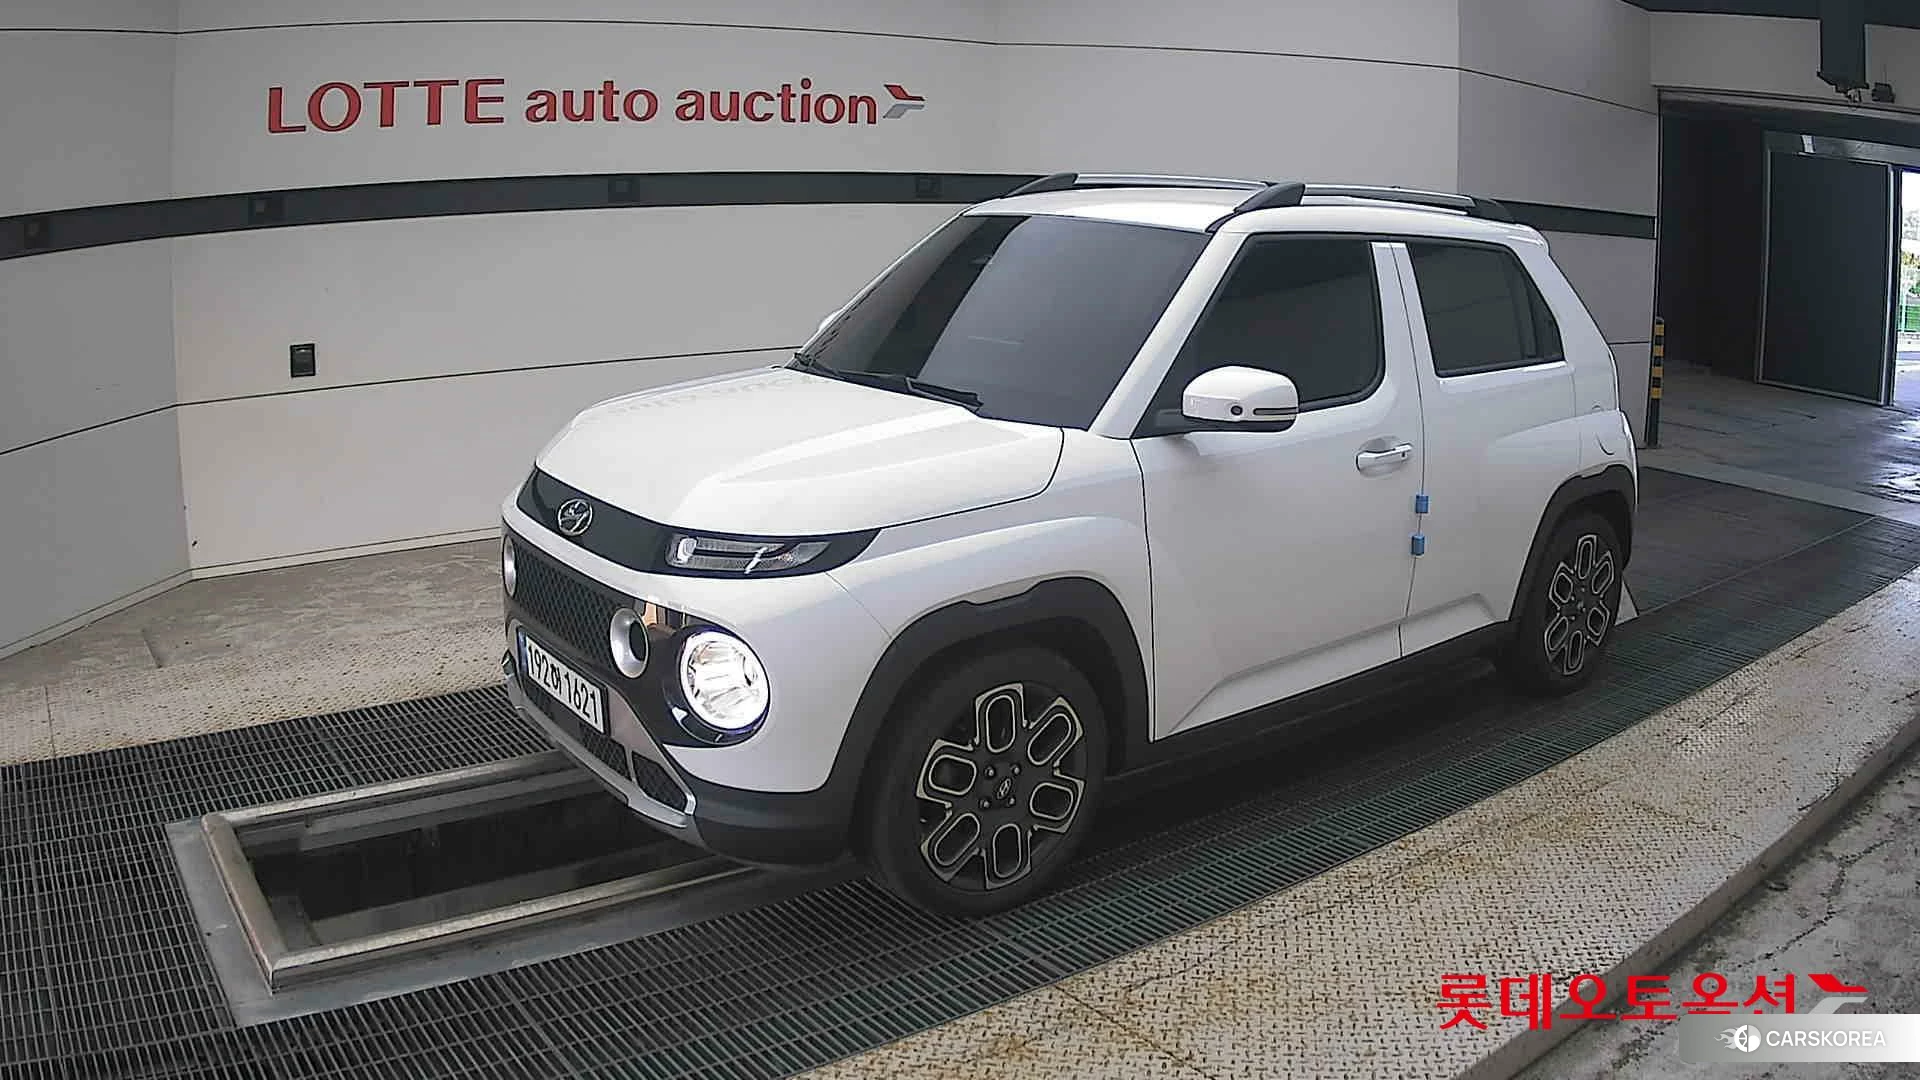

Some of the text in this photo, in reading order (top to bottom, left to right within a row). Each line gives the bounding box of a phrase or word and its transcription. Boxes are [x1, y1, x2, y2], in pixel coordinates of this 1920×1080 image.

[267, 78, 879, 134] LOTTE auto auction
[563, 671, 599, 725] 1621
